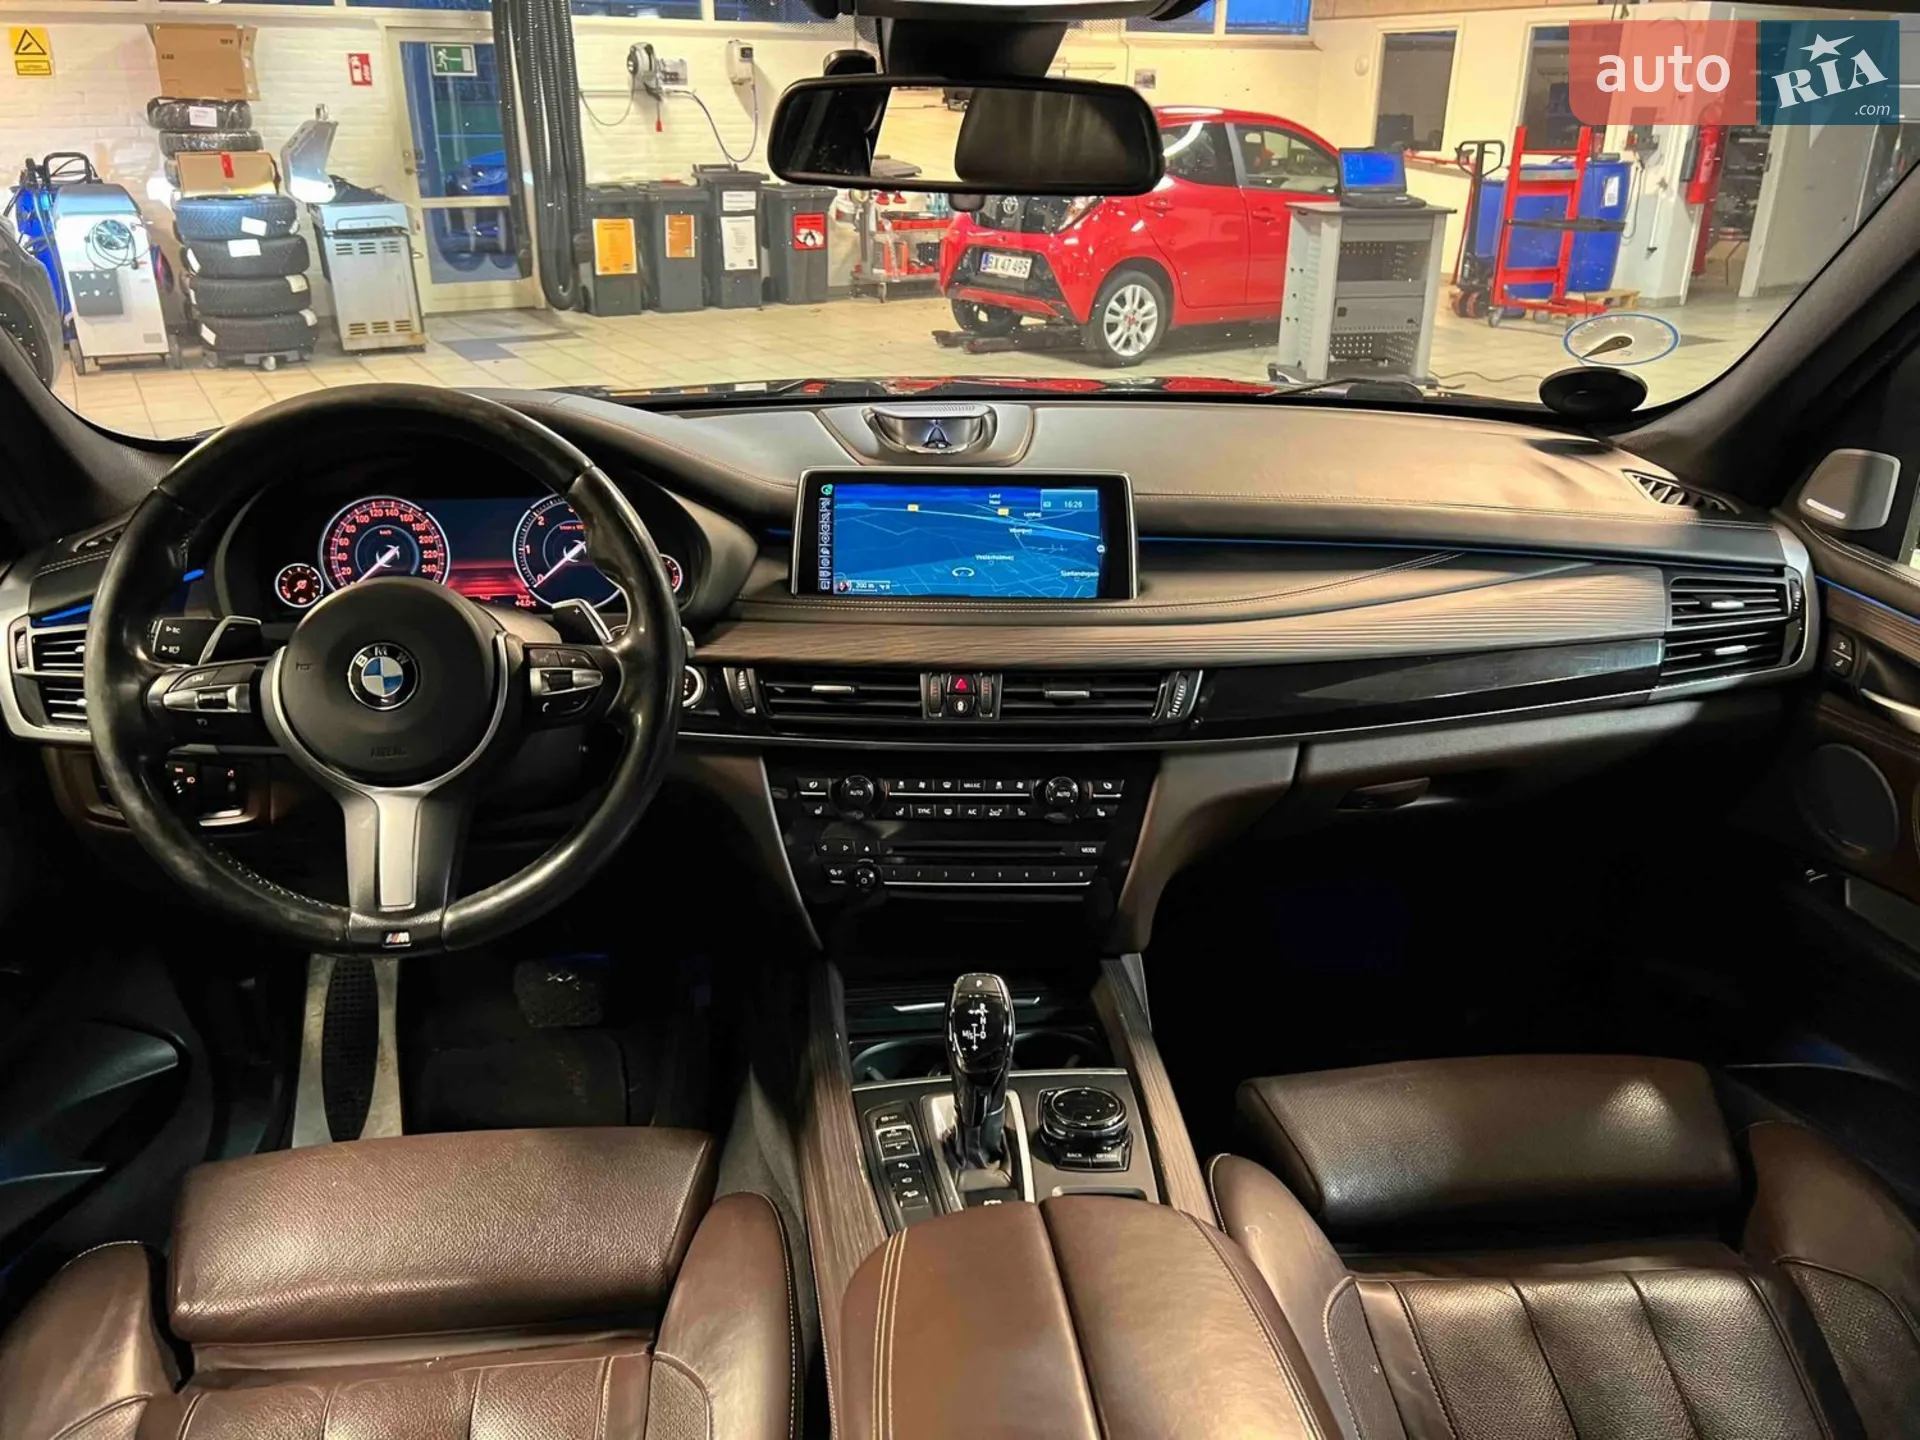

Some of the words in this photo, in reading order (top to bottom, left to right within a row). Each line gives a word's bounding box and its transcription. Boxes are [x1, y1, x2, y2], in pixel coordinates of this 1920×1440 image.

[1064, 500, 1083, 508] 16:26
[369, 509, 384, 517] 120
[385, 508, 400, 517] 140
[355, 514, 370, 523] 100
[399, 514, 414, 522] 160
[537, 515, 545, 526] 2
[345, 524, 356, 533] 80
[411, 523, 426, 531] 180
[338, 538, 350, 546] 60
[418, 535, 434, 544] 200
[525, 544, 531, 554] 1
[337, 552, 348, 561] 40
[422, 549, 438, 559] 220
[341, 566, 352, 575] 20
[421, 564, 437, 573] 240
[355, 646, 410, 668] BMW
[976, 979, 983, 988] P
[980, 1031, 987, 1040] D
